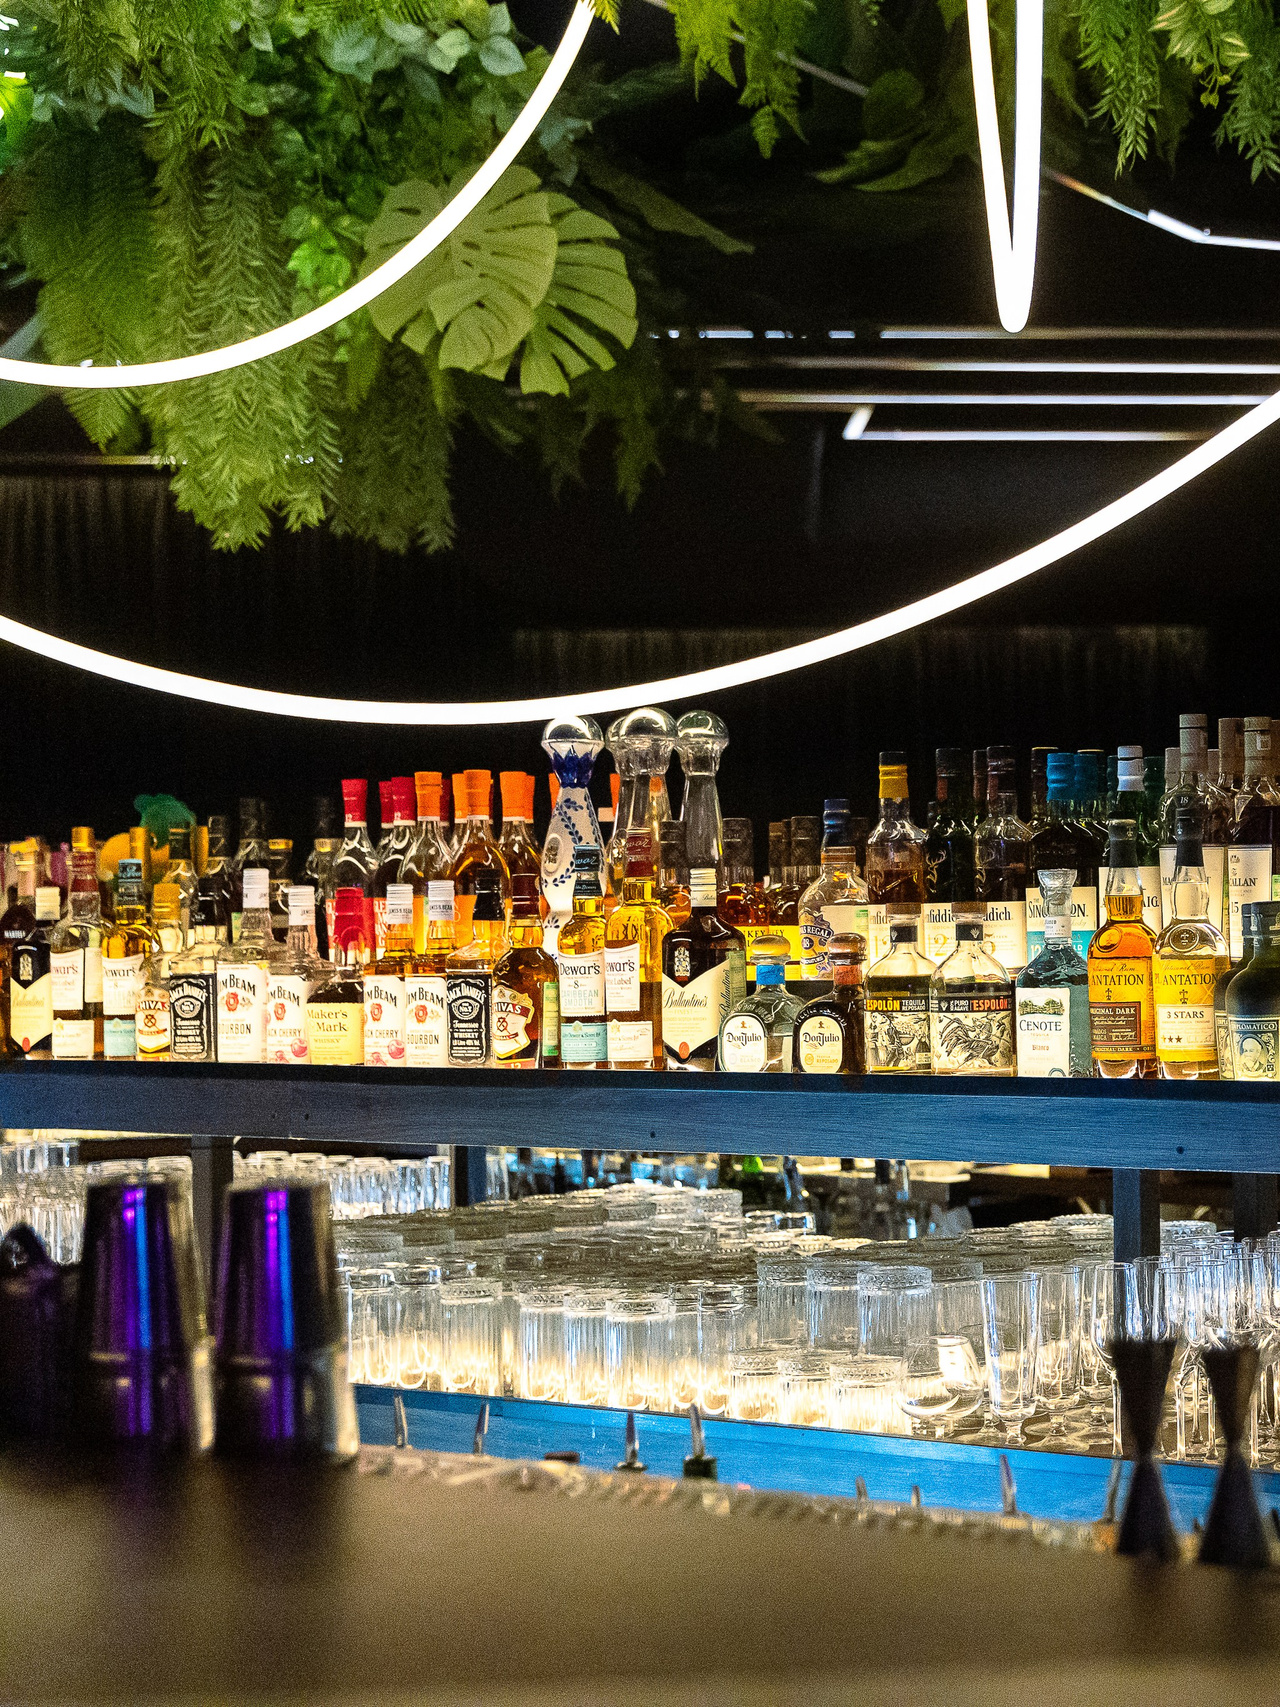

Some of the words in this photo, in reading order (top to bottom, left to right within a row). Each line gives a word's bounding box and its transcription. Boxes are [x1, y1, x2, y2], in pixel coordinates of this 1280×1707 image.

[1230, 901, 1240, 914] 15
[806, 926, 830, 938] REGAL
[559, 962, 601, 976] Dewar's
[606, 959, 635, 972] ewar's
[1118, 963, 1136, 972] Rum
[229, 973, 256, 997] BEAM
[574, 980, 580, 990] 8
[1091, 973, 1145, 986] ANTATION
[1154, 972, 1217, 986] PLANTATION
[277, 985, 300, 1008] BEAM
[374, 985, 398, 1009] BEAM
[418, 986, 444, 1010] BEAM
[446, 986, 462, 1004] JACK
[460, 982, 487, 1005] DANIEL'S
[663, 987, 709, 1009] Ballantine's
[306, 1008, 348, 1020] Maker's
[493, 1002, 522, 1014] HIVAS
[1115, 1007, 1136, 1015] DARK
[1166, 1011, 1171, 1019] 3
[1173, 1010, 1205, 1019] STARS
[316, 1021, 348, 1033] Mark
[1019, 1019, 1063, 1032] CENOTE
[279, 1028, 302, 1037] CHERRY
[375, 1029, 399, 1038] CHERRY
